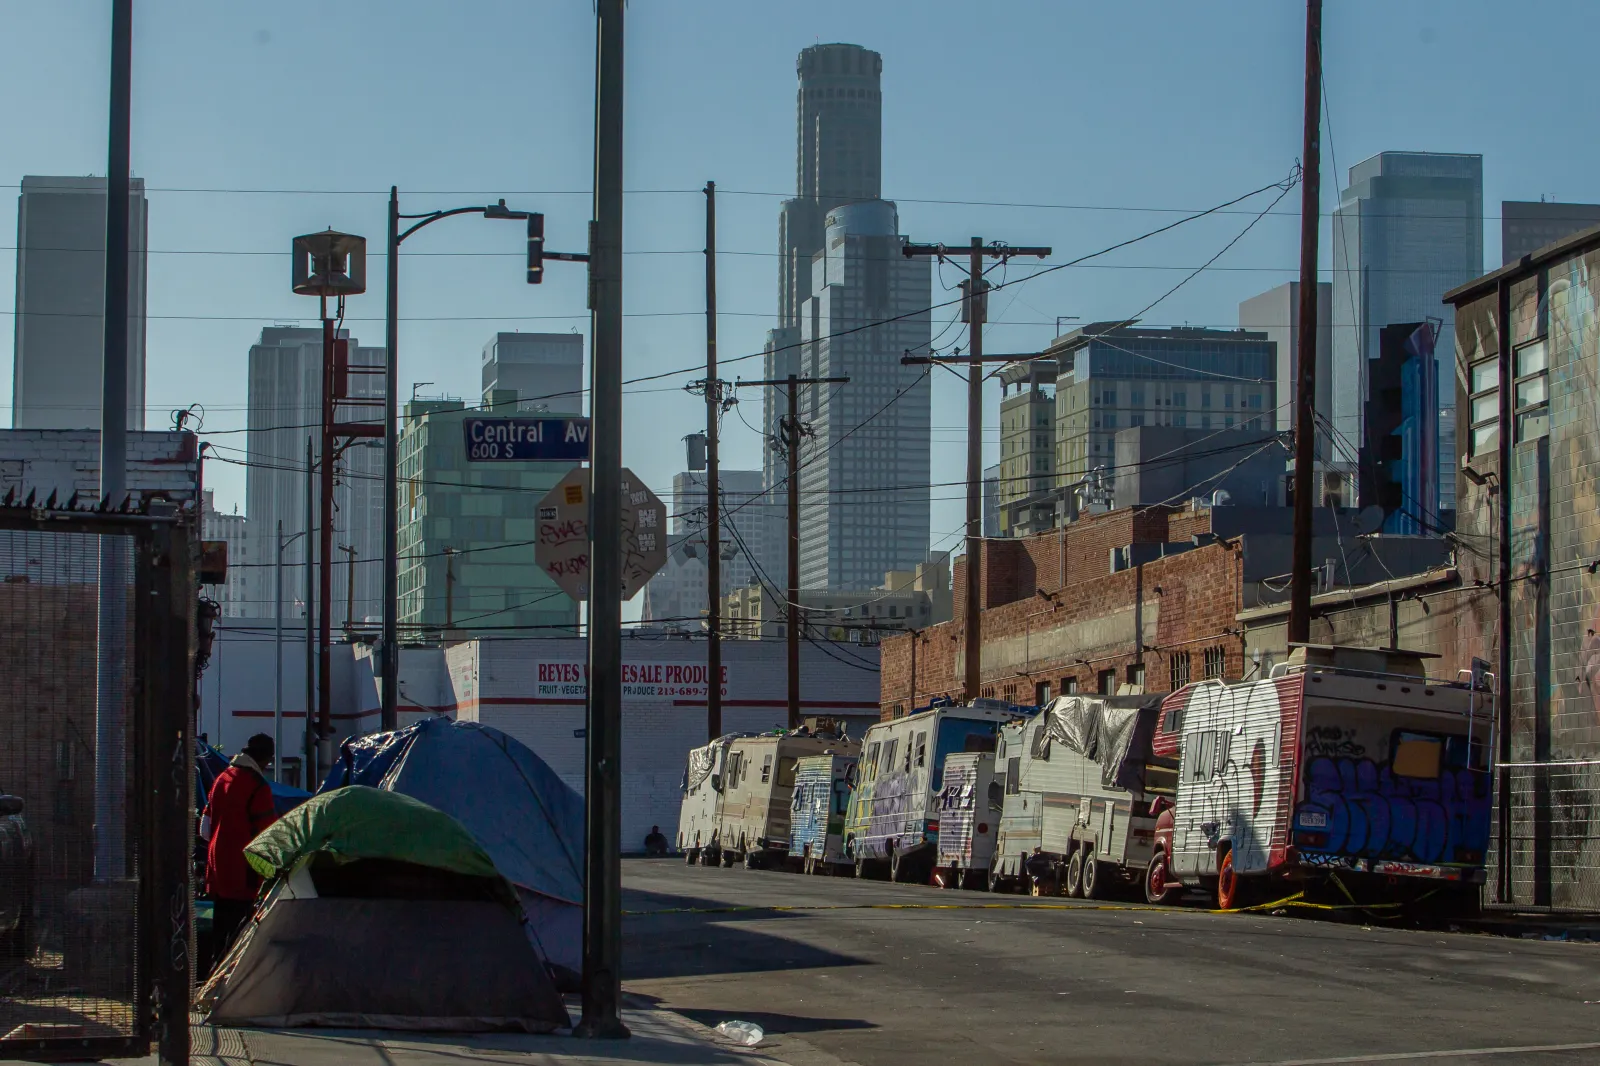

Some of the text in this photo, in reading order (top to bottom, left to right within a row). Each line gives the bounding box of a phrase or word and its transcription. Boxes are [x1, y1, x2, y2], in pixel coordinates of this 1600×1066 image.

[471, 420, 588, 443] Central Av
[471, 443, 514, 458] 600 S
[538, 663, 580, 682] REYES
[665, 665, 728, 684] PRODUE
[657, 686, 727, 696] 213-689-70
